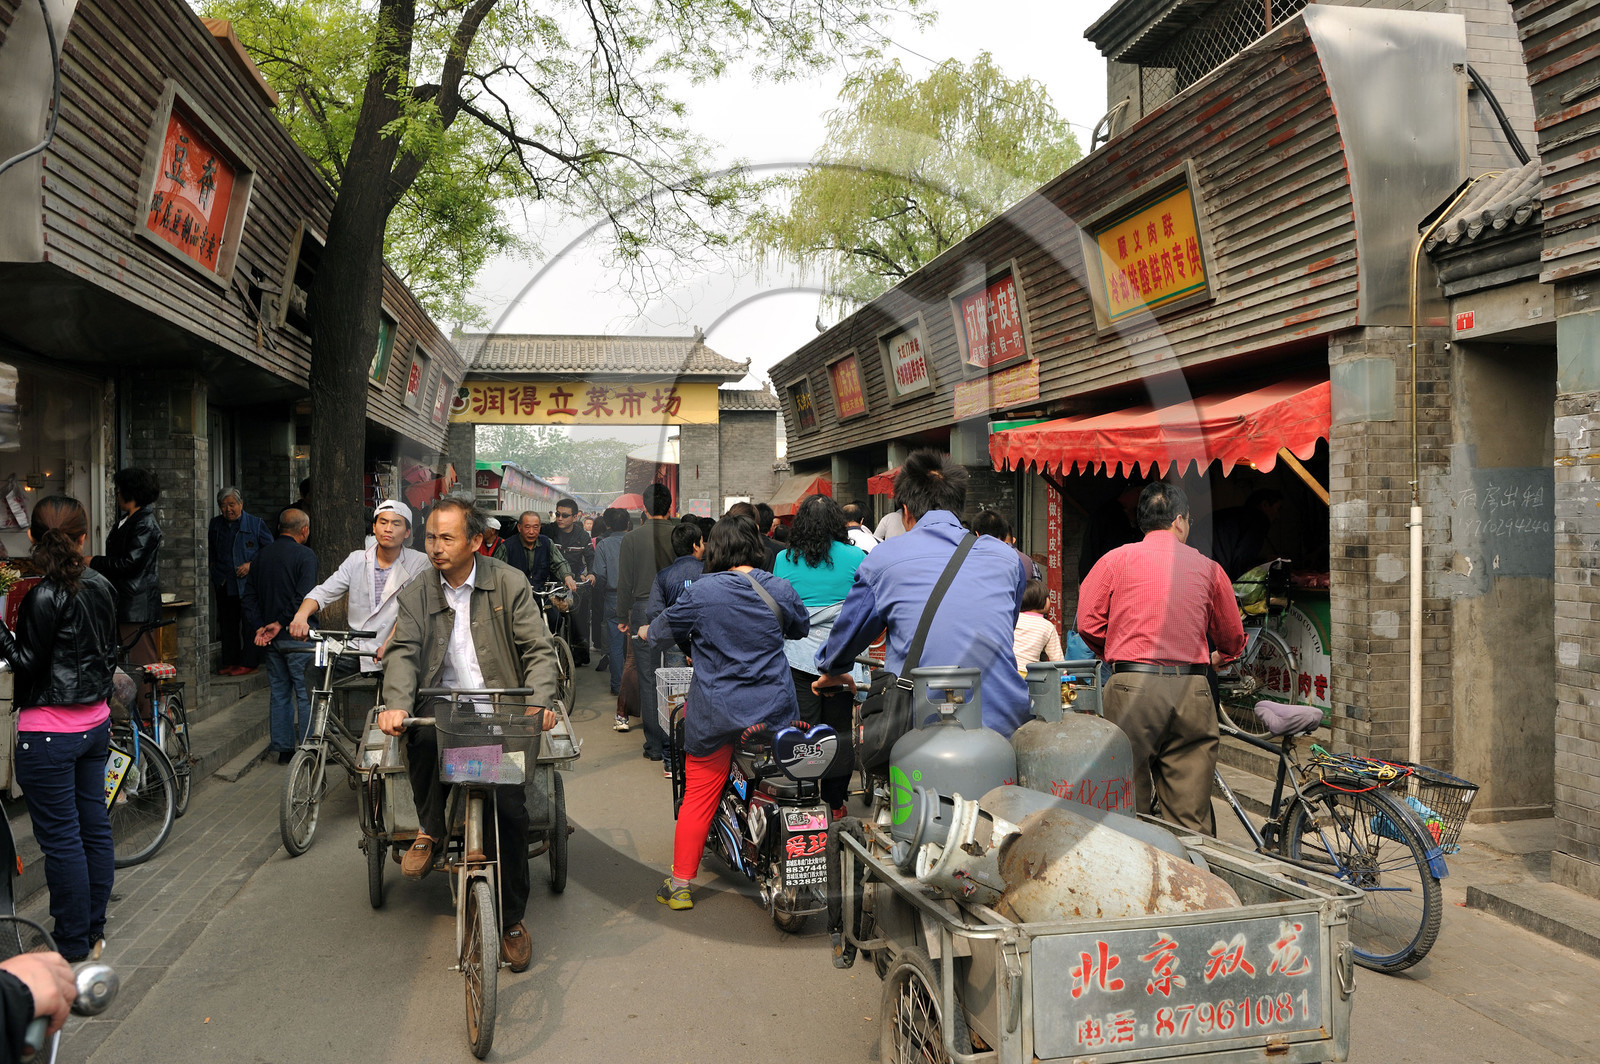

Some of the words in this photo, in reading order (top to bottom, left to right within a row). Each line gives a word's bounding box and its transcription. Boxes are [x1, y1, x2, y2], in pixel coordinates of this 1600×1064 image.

[1117, 211, 1175, 260] 顺义肉联
[1108, 235, 1203, 304] 冷却排酸鲜肉专供
[999, 330, 1023, 353] 假一罚
[472, 385, 682, 418] 润得立菜市场
[1068, 922, 1312, 999] 北京双龙
